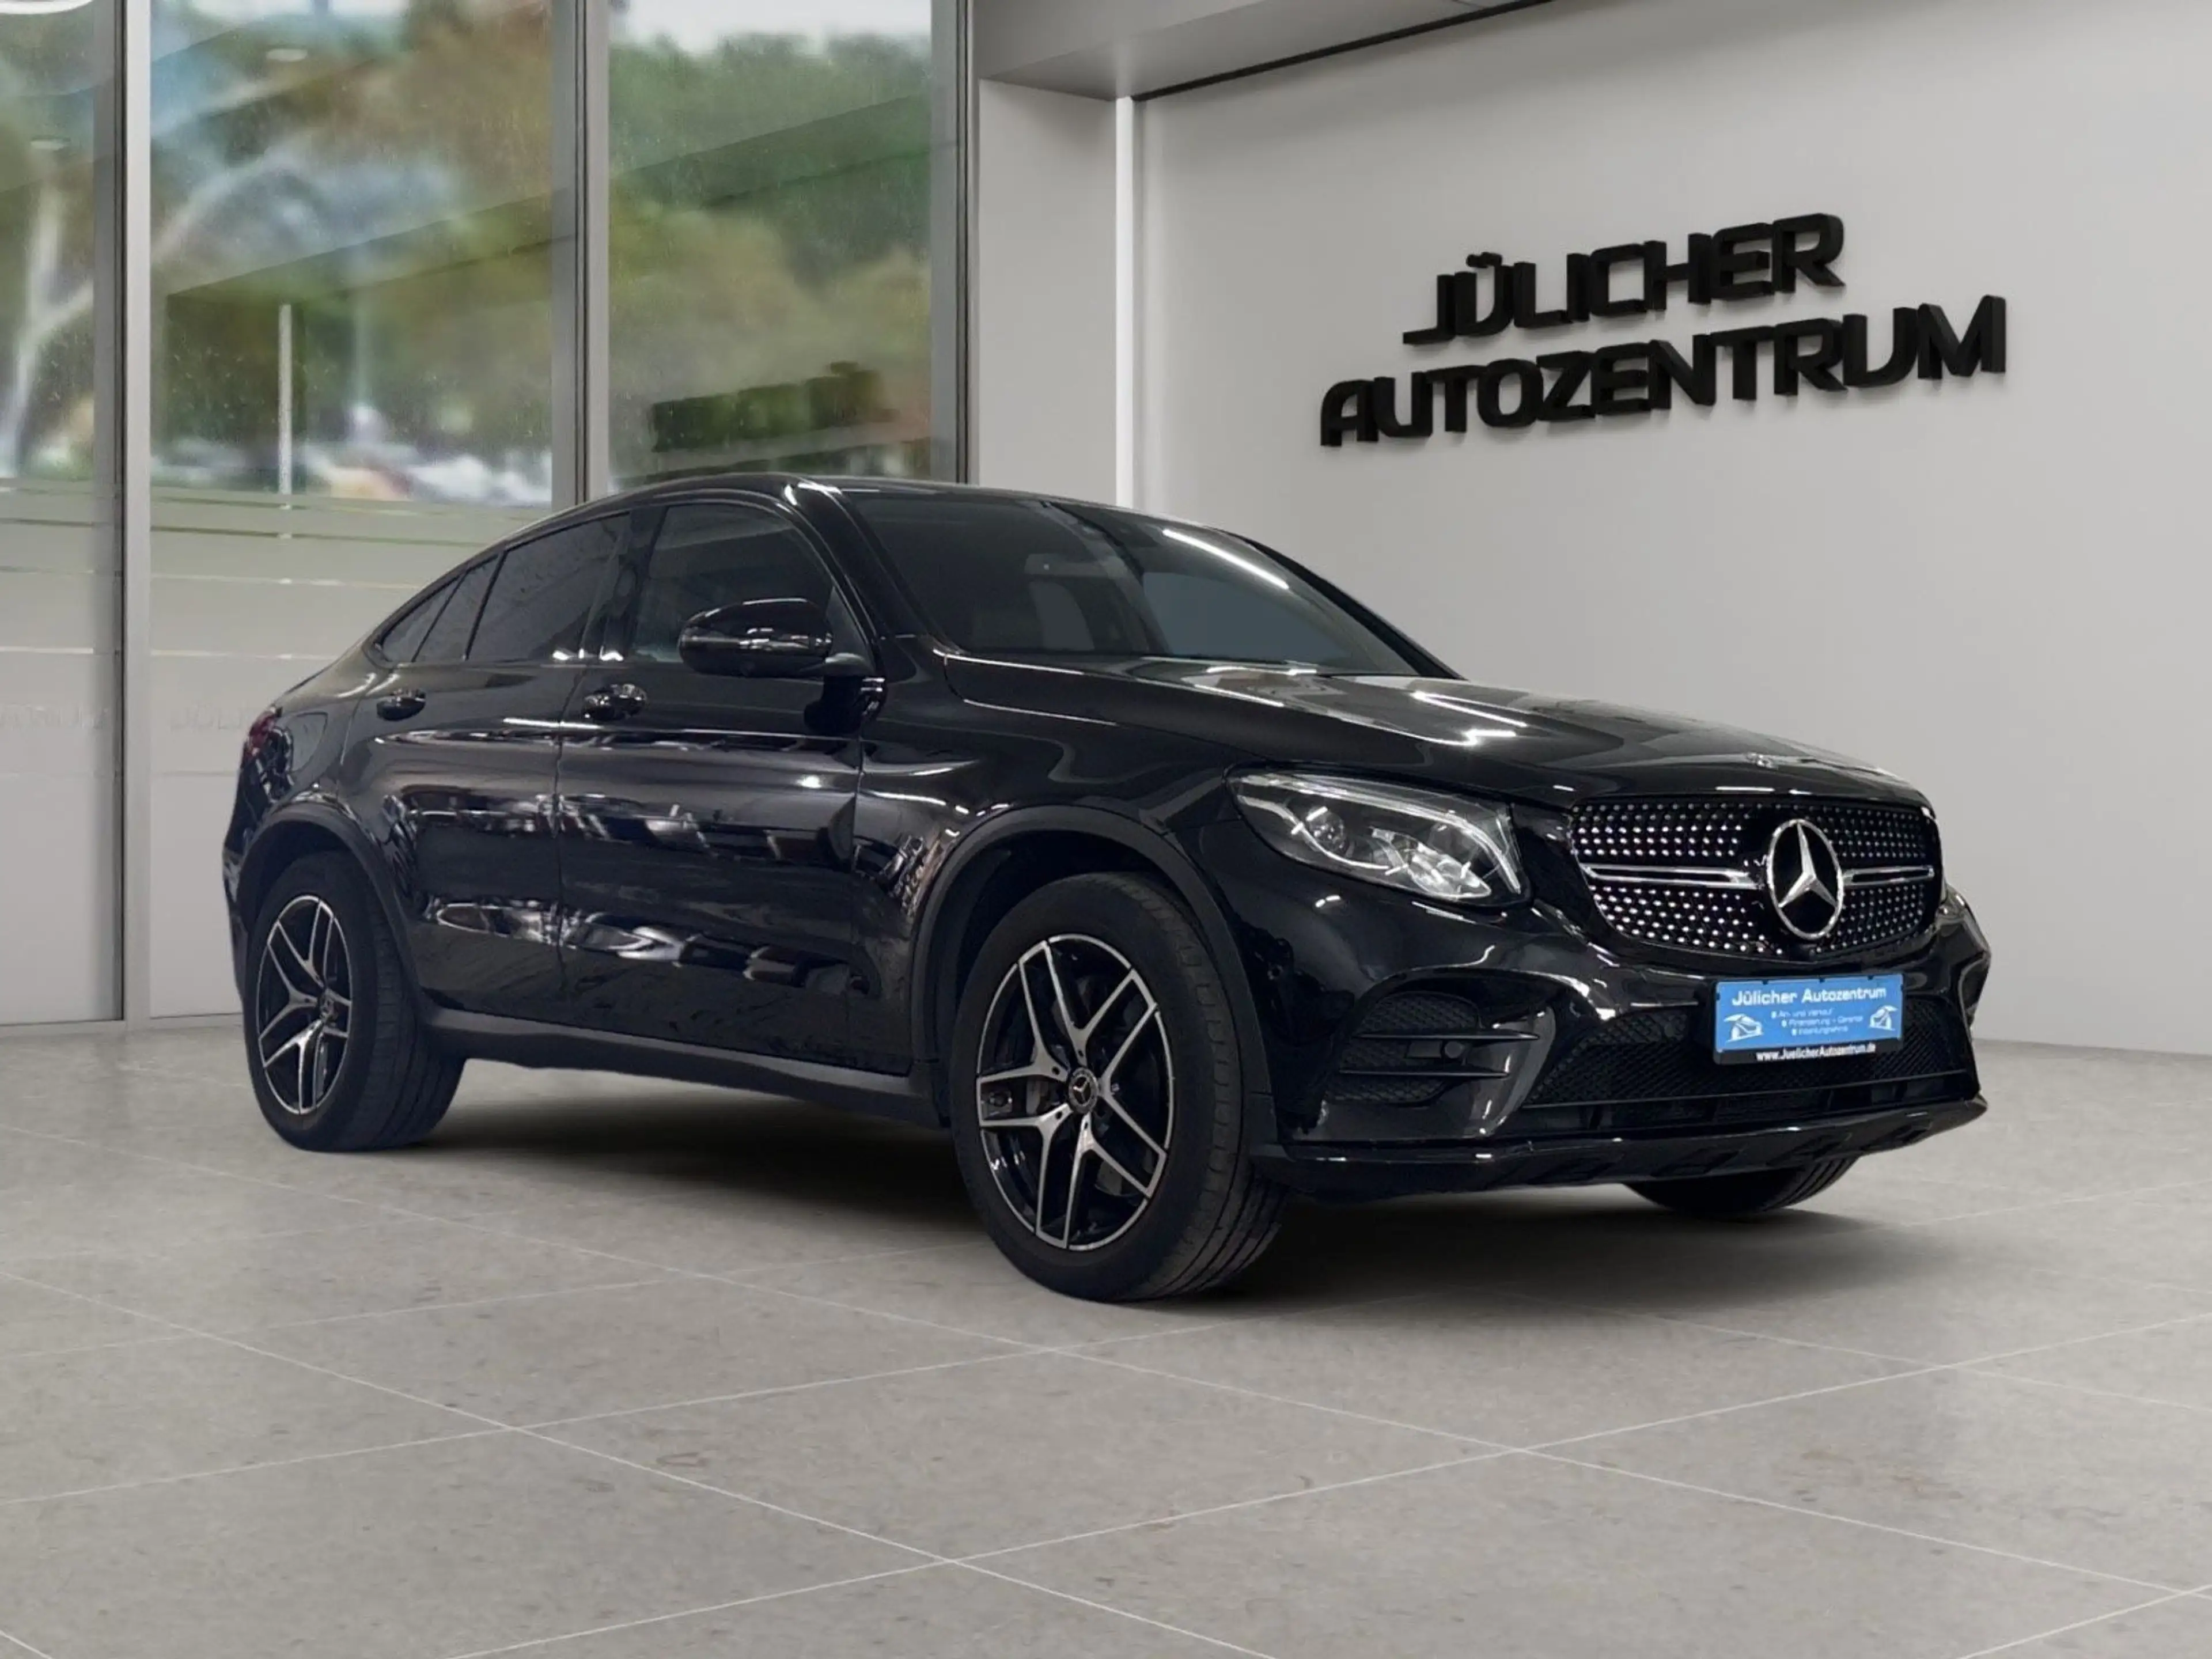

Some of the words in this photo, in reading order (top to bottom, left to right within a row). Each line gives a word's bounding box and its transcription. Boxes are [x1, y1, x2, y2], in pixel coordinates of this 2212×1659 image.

[1402, 213, 1845, 347] JÜLICHER
[1320, 295, 2006, 448] AUTOZENTRUM
[1732, 990, 1797, 1006] Jülicher
[1801, 987, 1887, 1003] Autozentrum
